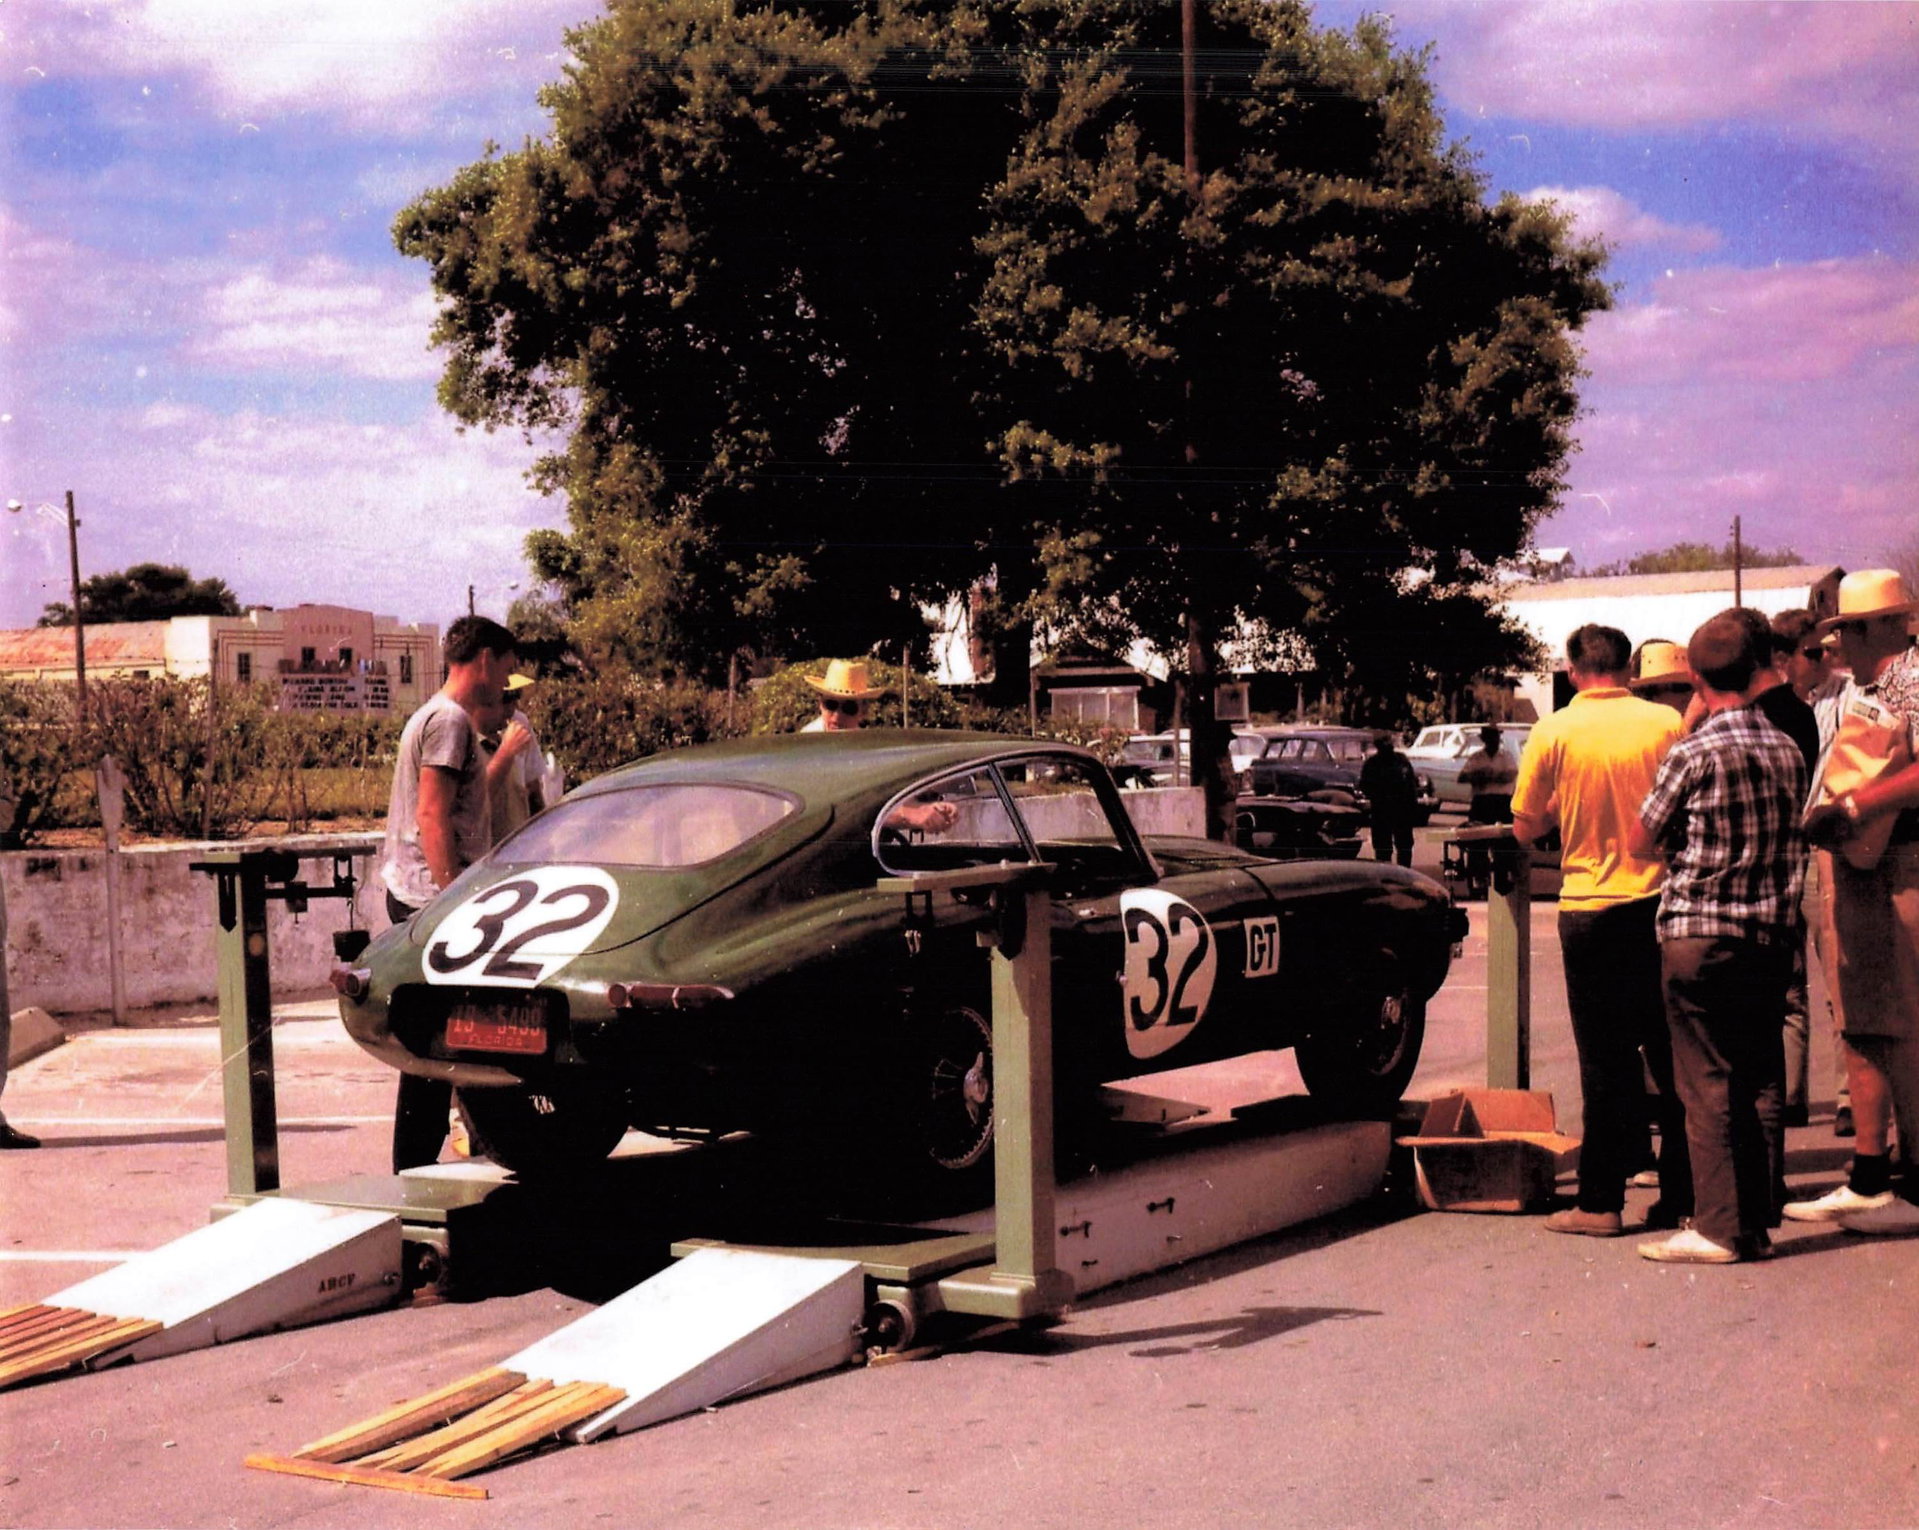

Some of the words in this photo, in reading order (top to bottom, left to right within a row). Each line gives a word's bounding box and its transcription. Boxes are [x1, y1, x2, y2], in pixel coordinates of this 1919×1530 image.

[429, 880, 610, 980] 32
[1125, 903, 1209, 1031] 32
[1250, 923, 1277, 971] GT
[468, 1033, 523, 1047] FLORIDA
